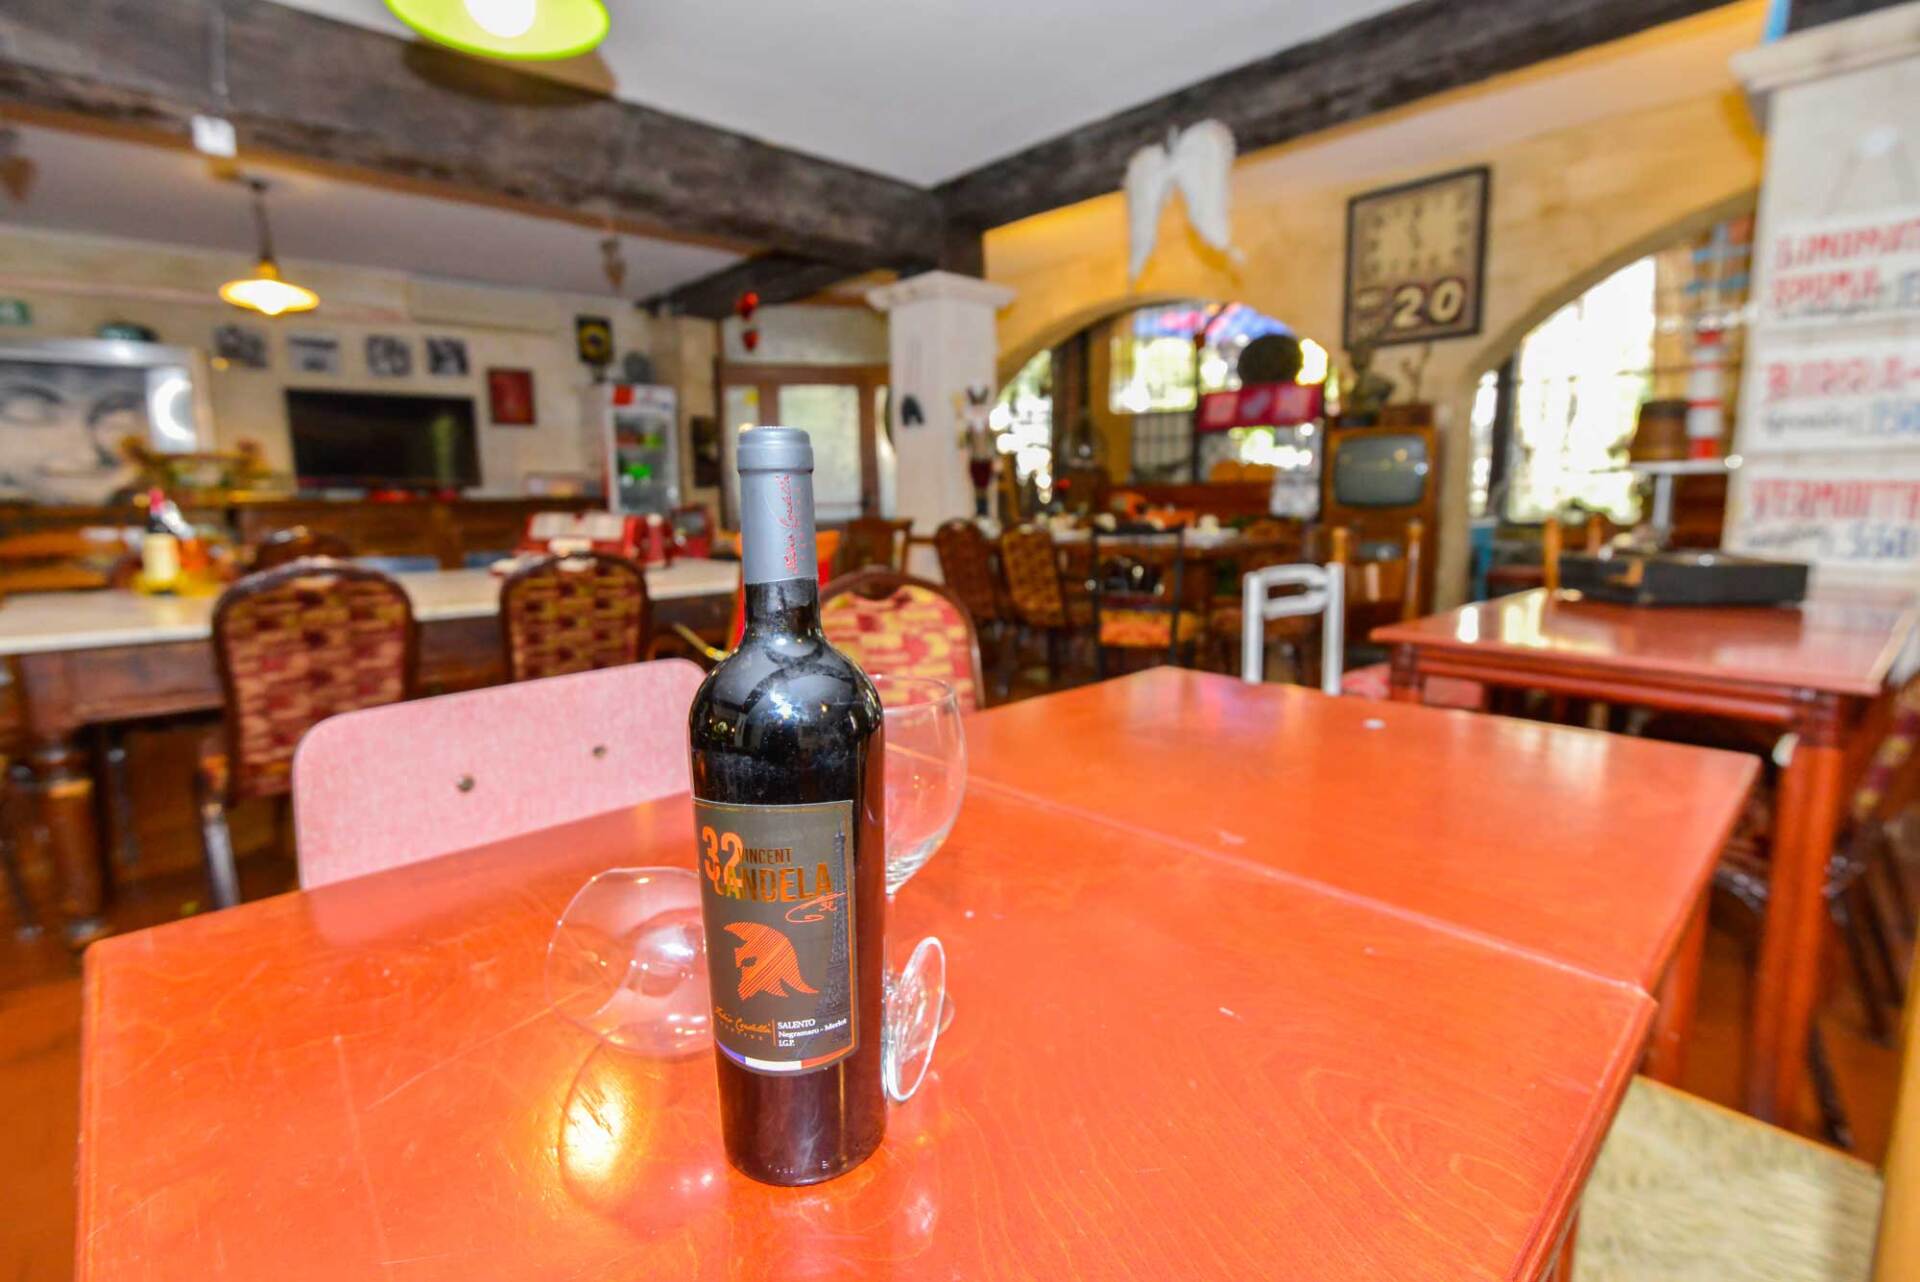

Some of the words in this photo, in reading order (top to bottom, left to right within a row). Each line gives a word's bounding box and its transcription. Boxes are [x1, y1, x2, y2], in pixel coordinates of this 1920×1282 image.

[1392, 279, 1465, 329] 20
[702, 825, 743, 888] 32
[737, 847, 793, 864] VINCENT
[778, 1018, 816, 1030] SALENTO
[824, 1018, 847, 1030] Merlot
